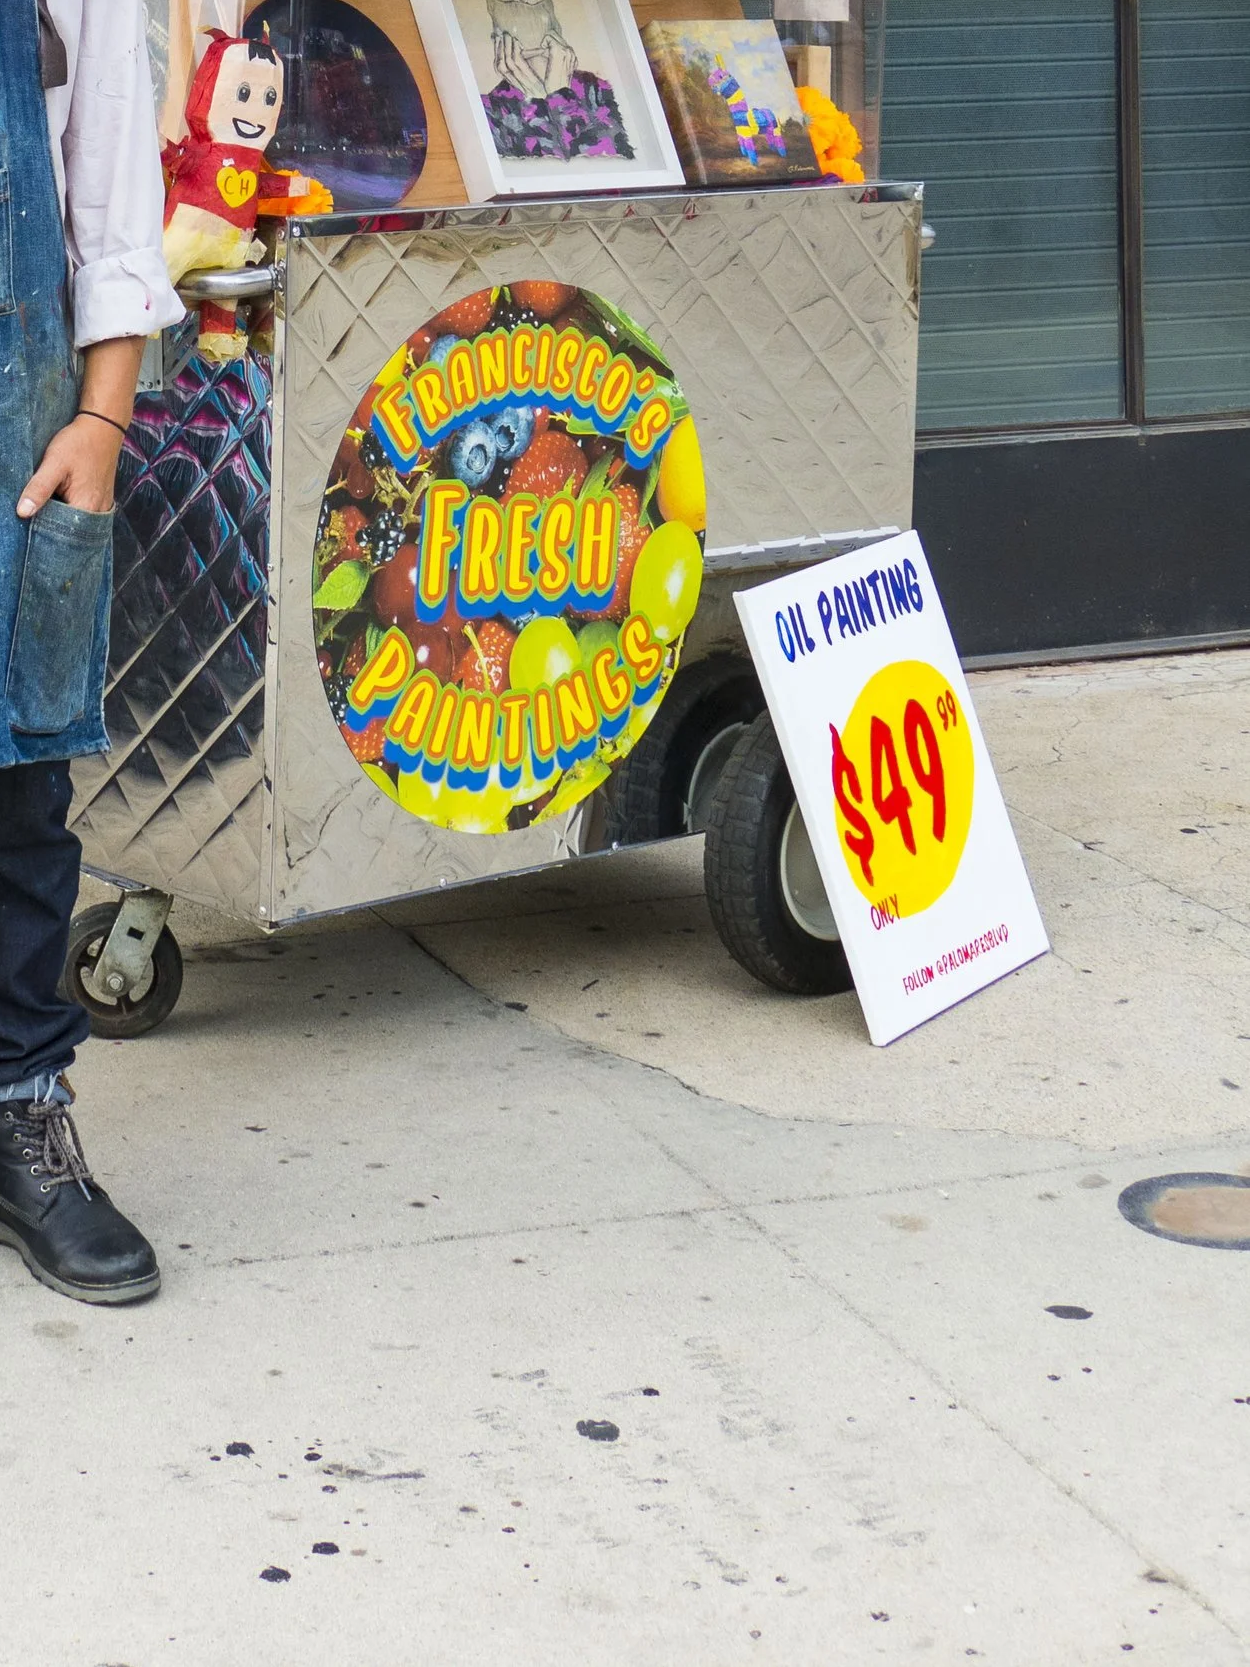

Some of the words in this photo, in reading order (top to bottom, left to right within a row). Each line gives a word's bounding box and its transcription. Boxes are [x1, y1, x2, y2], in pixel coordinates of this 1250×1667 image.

[374, 325, 673, 466] FRANCISCO'S
[419, 480, 618, 609] FRESH
[775, 601, 816, 663] OIL
[817, 558, 923, 646] PAINTING
[348, 611, 666, 779] PAINTINGS
[829, 699, 946, 887] $49
[870, 893, 901, 931] ONLY
[902, 965, 935, 996] FOLLOW
[936, 923, 1009, 976] @PALOMARESBLVD
